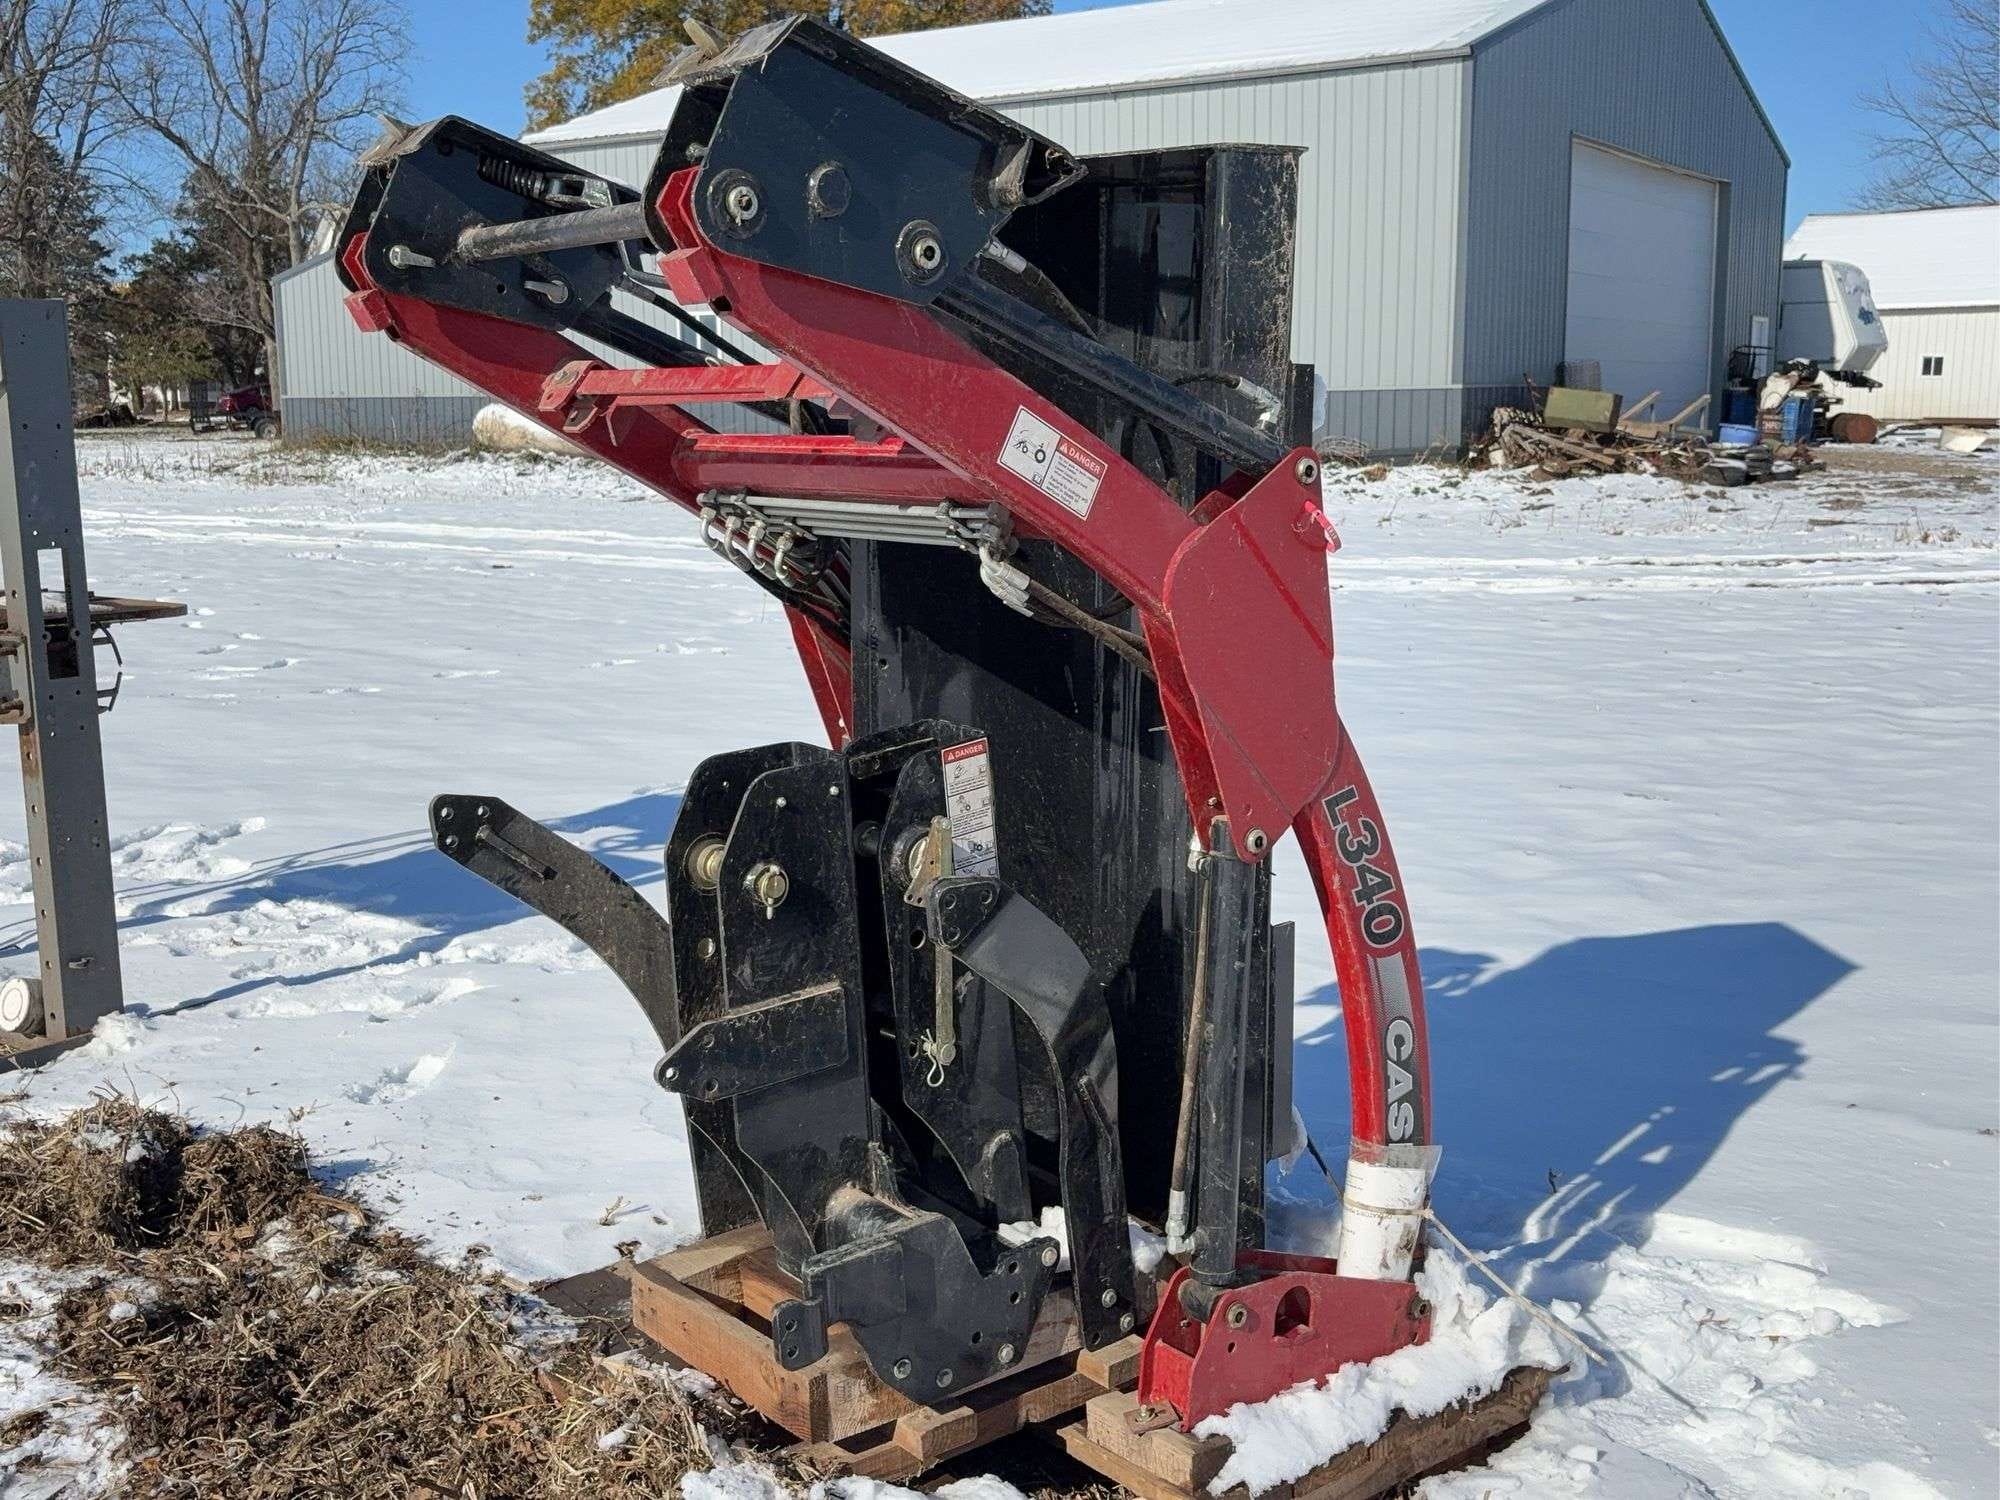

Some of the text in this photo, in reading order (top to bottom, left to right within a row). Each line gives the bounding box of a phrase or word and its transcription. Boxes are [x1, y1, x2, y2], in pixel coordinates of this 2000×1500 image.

[1068, 450, 1101, 473] DANGER
[954, 744, 984, 759] DANGER
[1322, 785, 1404, 948] L340
[1386, 1019, 1414, 1147] CAS
